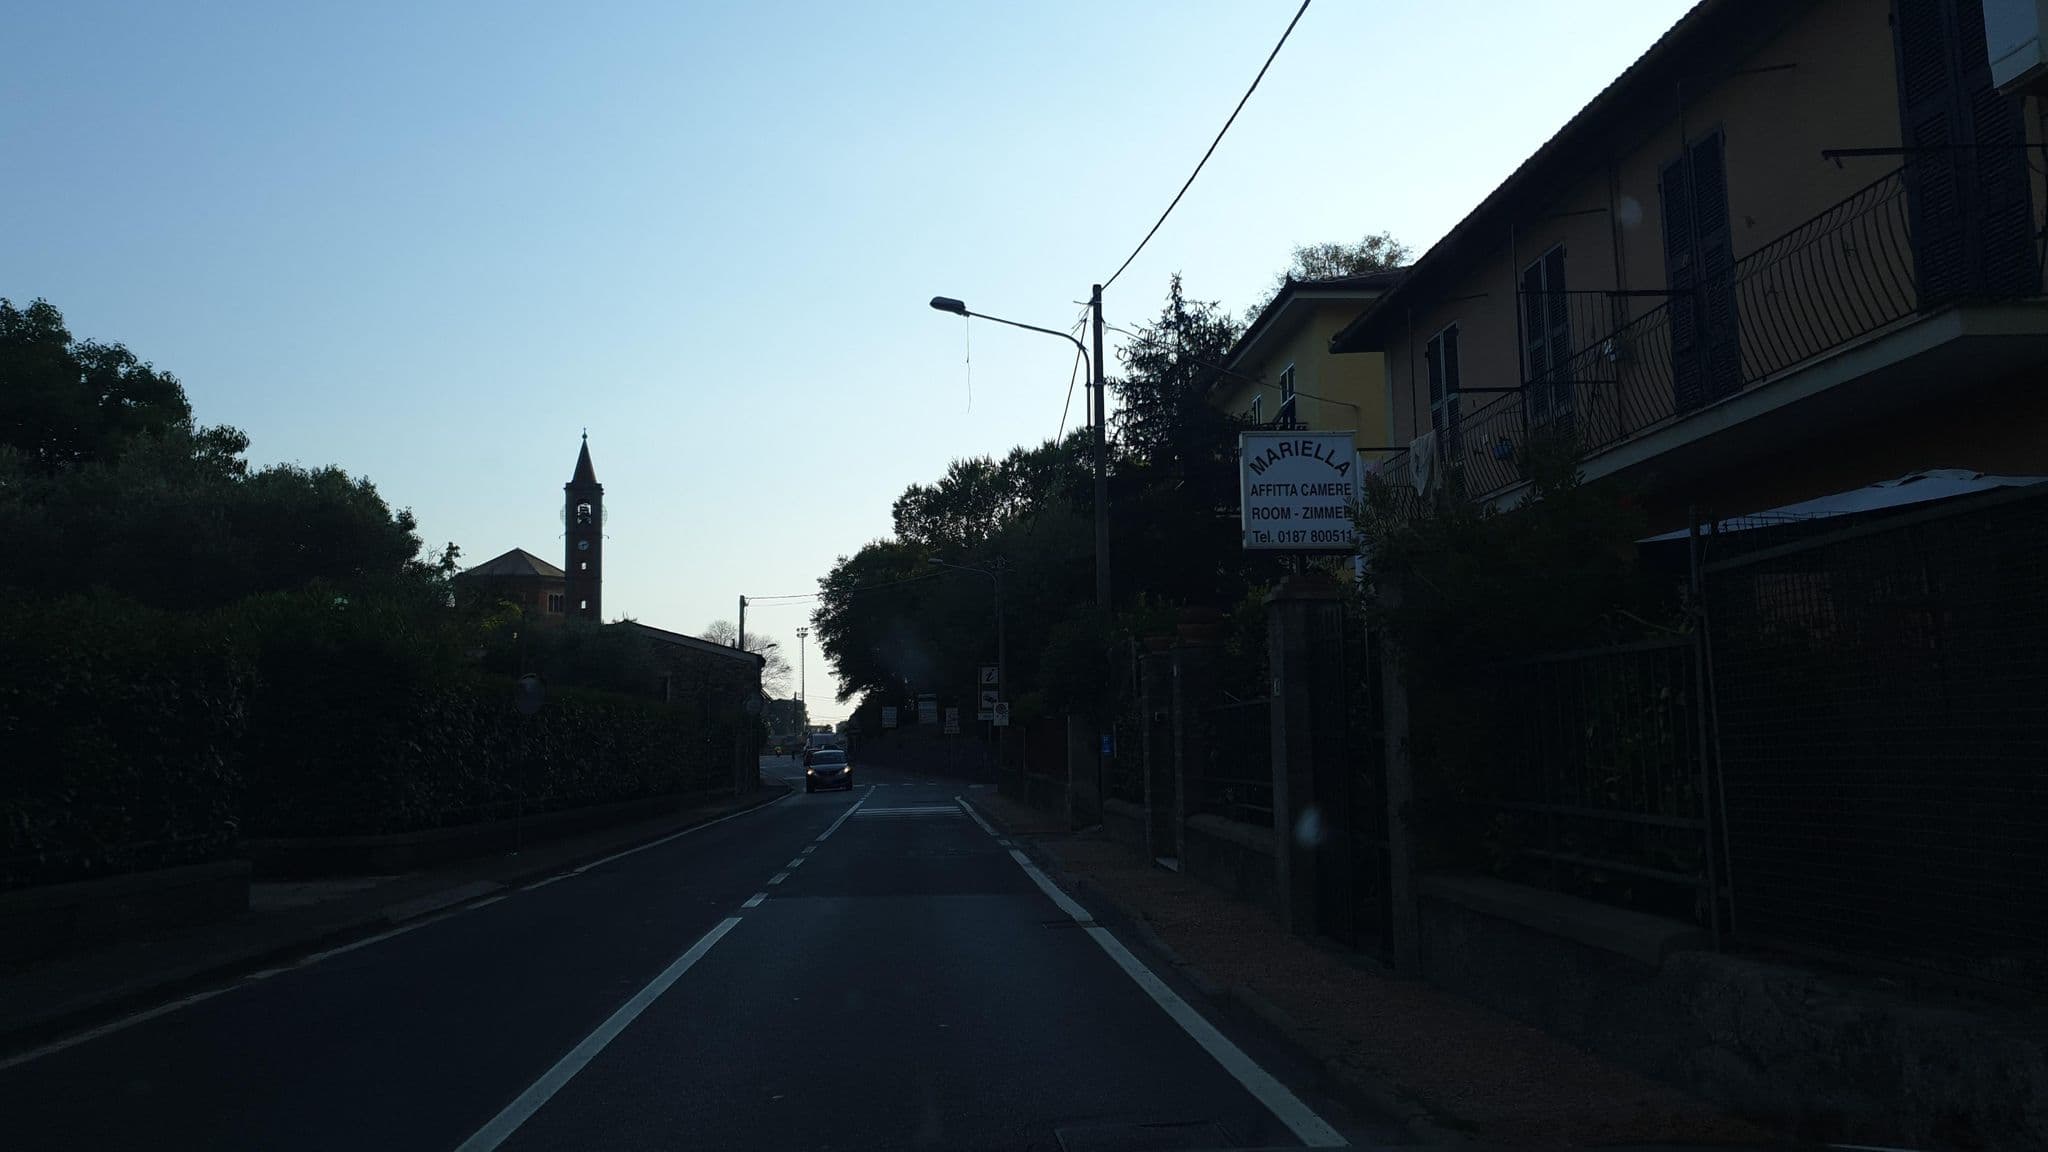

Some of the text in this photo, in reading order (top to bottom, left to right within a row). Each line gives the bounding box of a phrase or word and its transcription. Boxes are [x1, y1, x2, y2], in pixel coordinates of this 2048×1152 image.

[1249, 440, 1350, 476] MARIELLA
[1250, 483, 1351, 496] AFFITTA CAMERE
[1252, 507, 1291, 519] ROOM
[1252, 530, 1352, 543] Tel. 0187 800511
